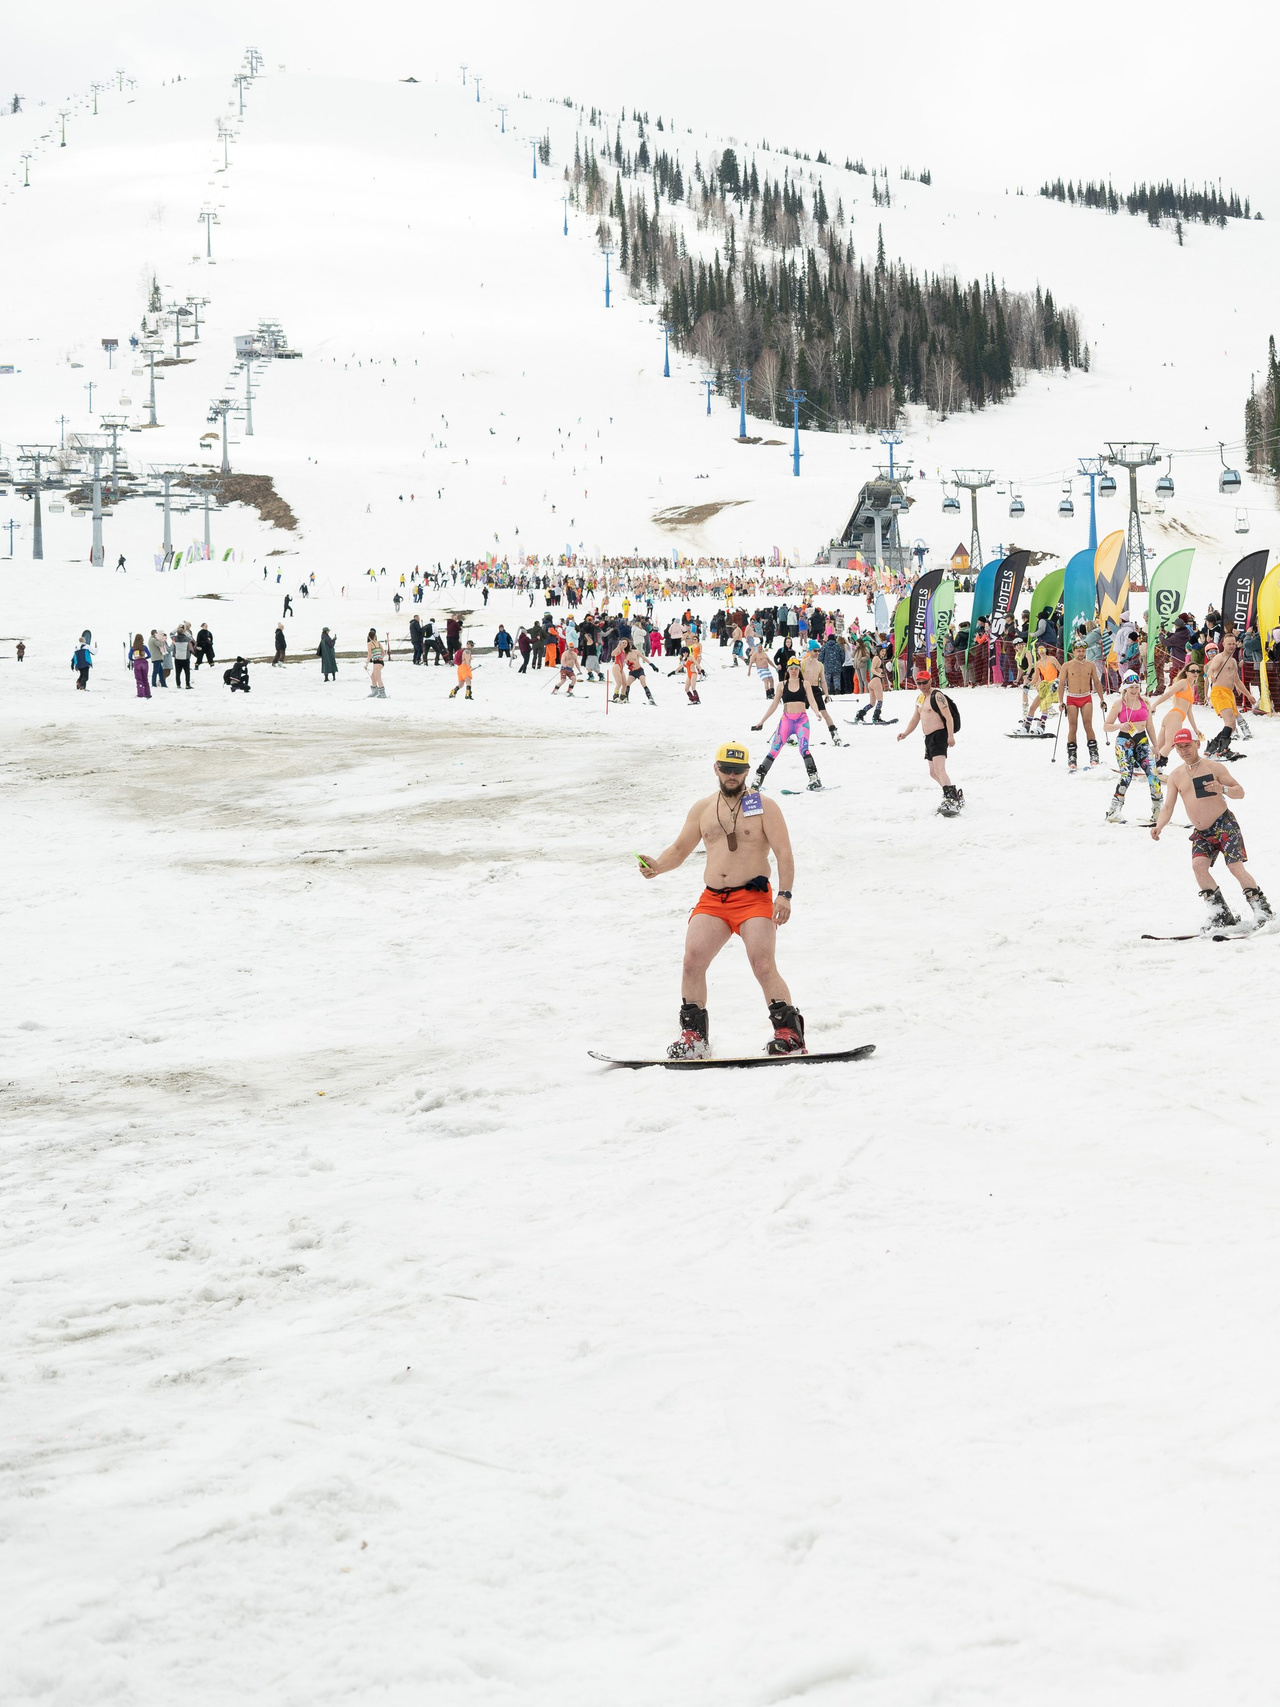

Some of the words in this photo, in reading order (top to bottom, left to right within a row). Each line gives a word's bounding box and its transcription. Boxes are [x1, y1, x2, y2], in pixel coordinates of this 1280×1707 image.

[915, 588, 928, 628] HOTELS
[996, 570, 1014, 612] HOTELS
[1234, 577, 1251, 632] HOTELS
